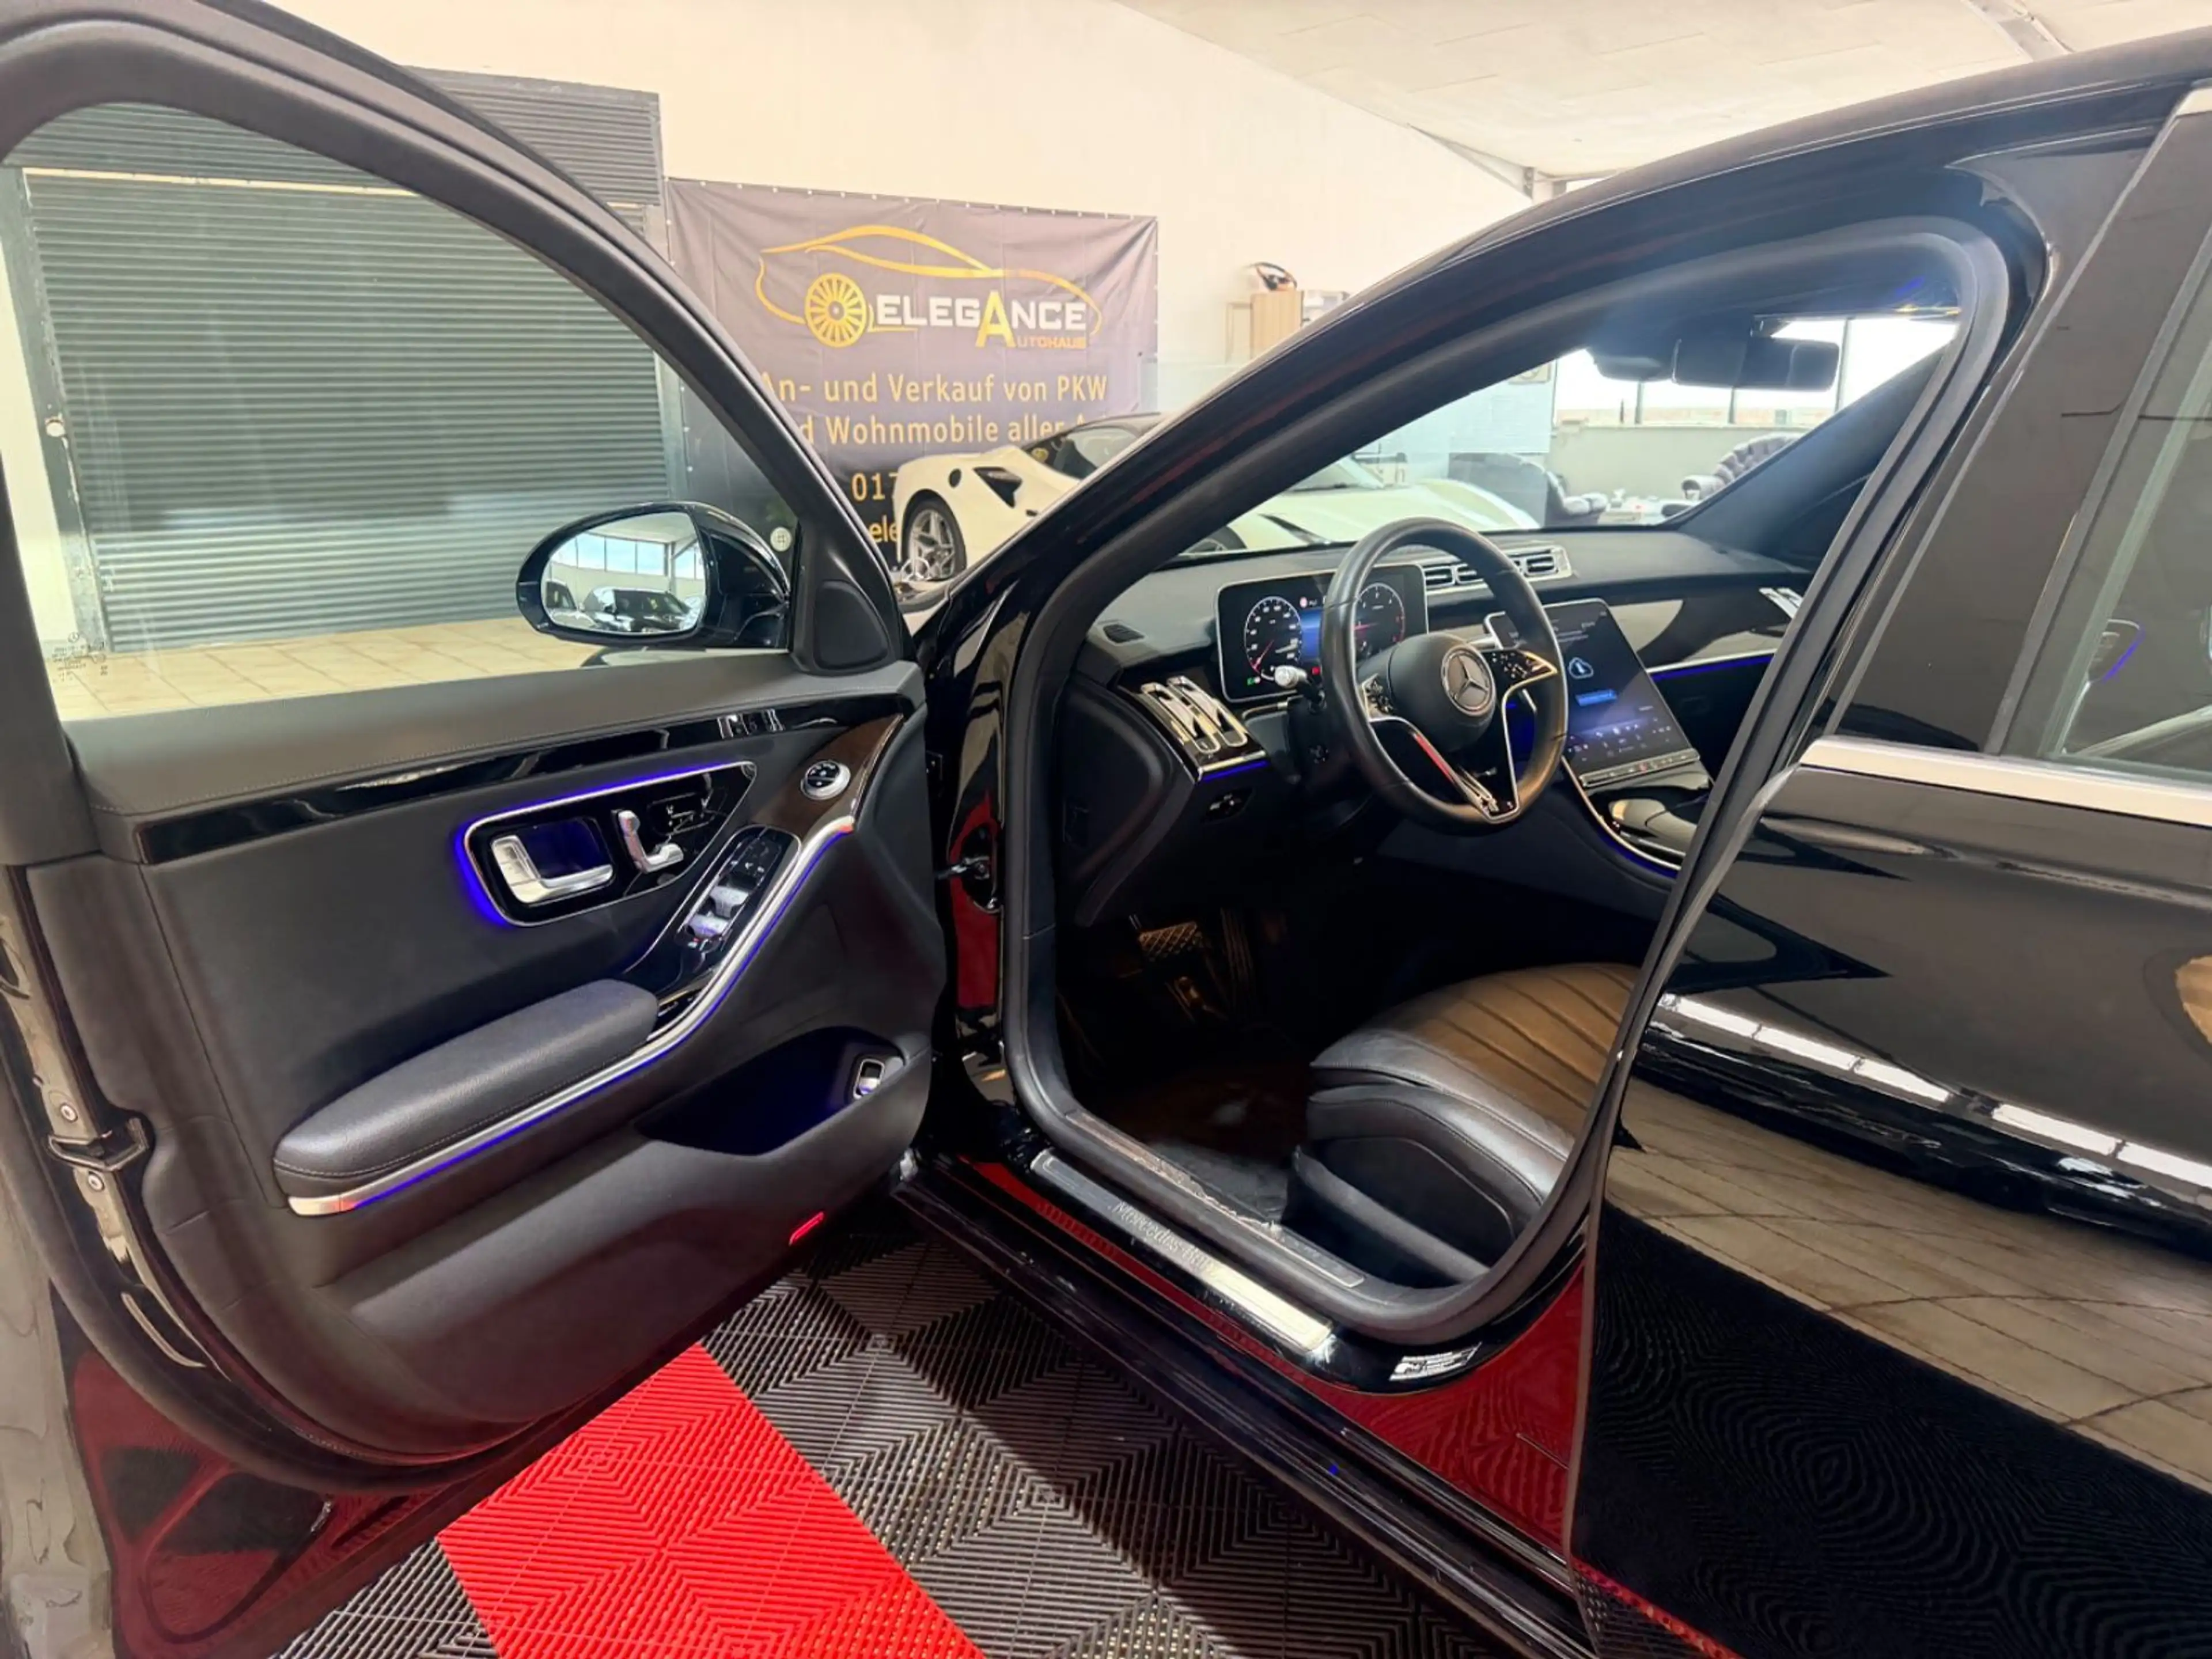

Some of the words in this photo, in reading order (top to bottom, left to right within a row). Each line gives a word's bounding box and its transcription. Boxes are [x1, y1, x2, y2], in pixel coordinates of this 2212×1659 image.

[876, 290, 1086, 349] ELEGANCE
[824, 372, 878, 402] und
[887, 373, 995, 402] Verkauf
[1003, 381, 1047, 402] von
[1057, 375, 1108, 402] PKW
[825, 414, 999, 444] Wohnmobile
